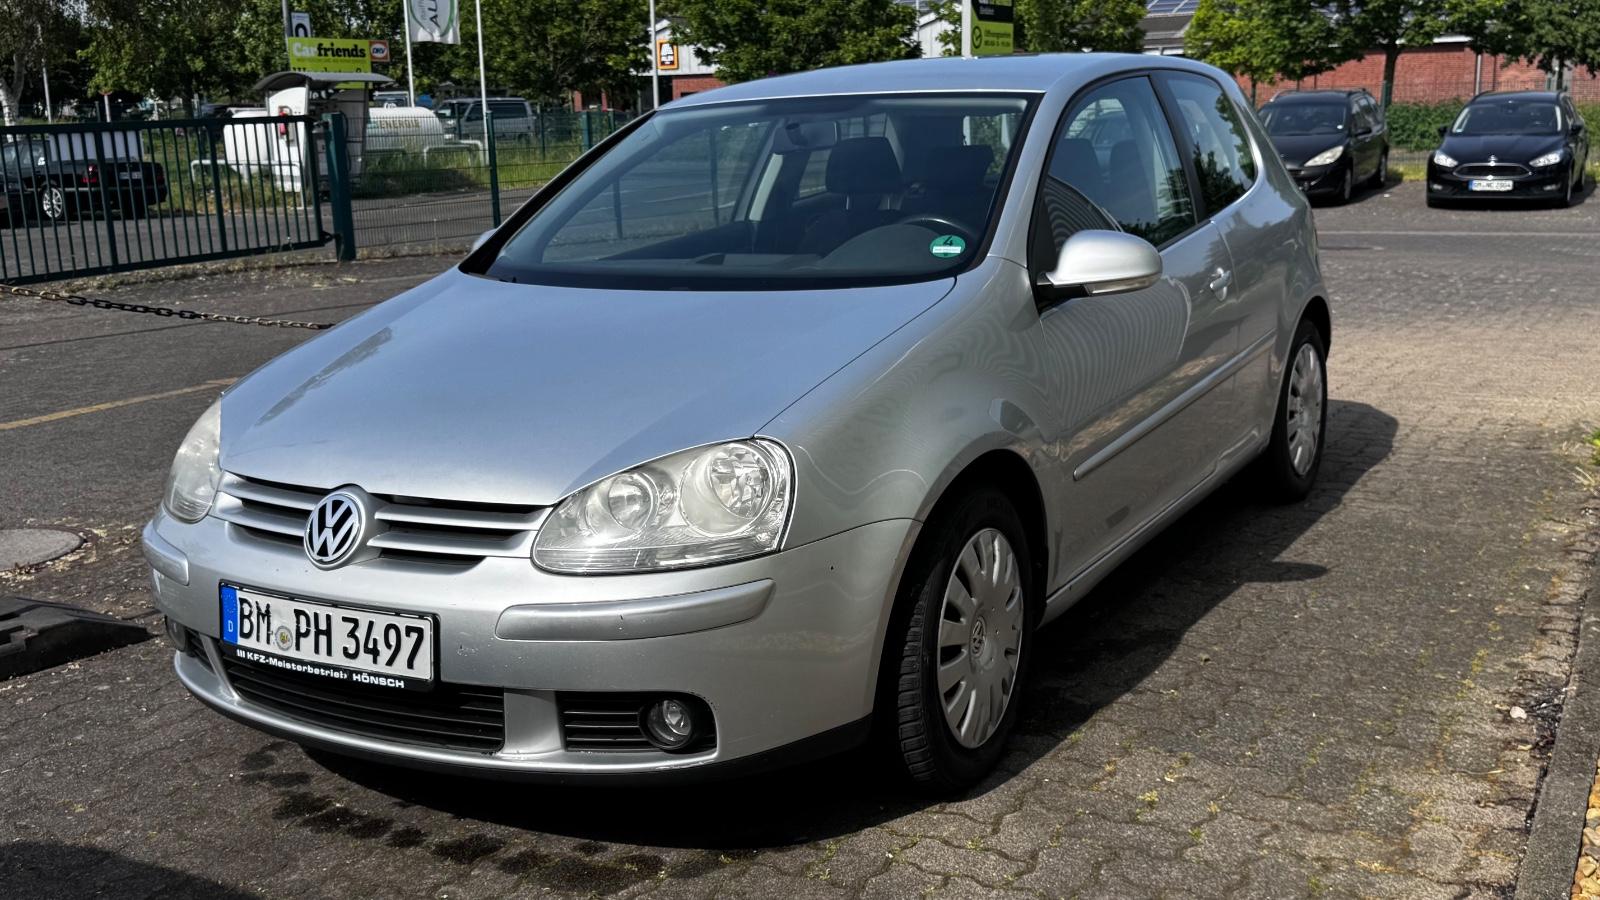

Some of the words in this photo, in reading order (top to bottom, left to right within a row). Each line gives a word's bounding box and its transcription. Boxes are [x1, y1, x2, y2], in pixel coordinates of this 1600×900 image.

[943, 236, 953, 246] 4
[227, 620, 234, 633] D
[239, 597, 272, 645] BM
[294, 608, 333, 657] PH
[342, 616, 424, 670] 3497
[352, 672, 405, 689] HÖNSCH
